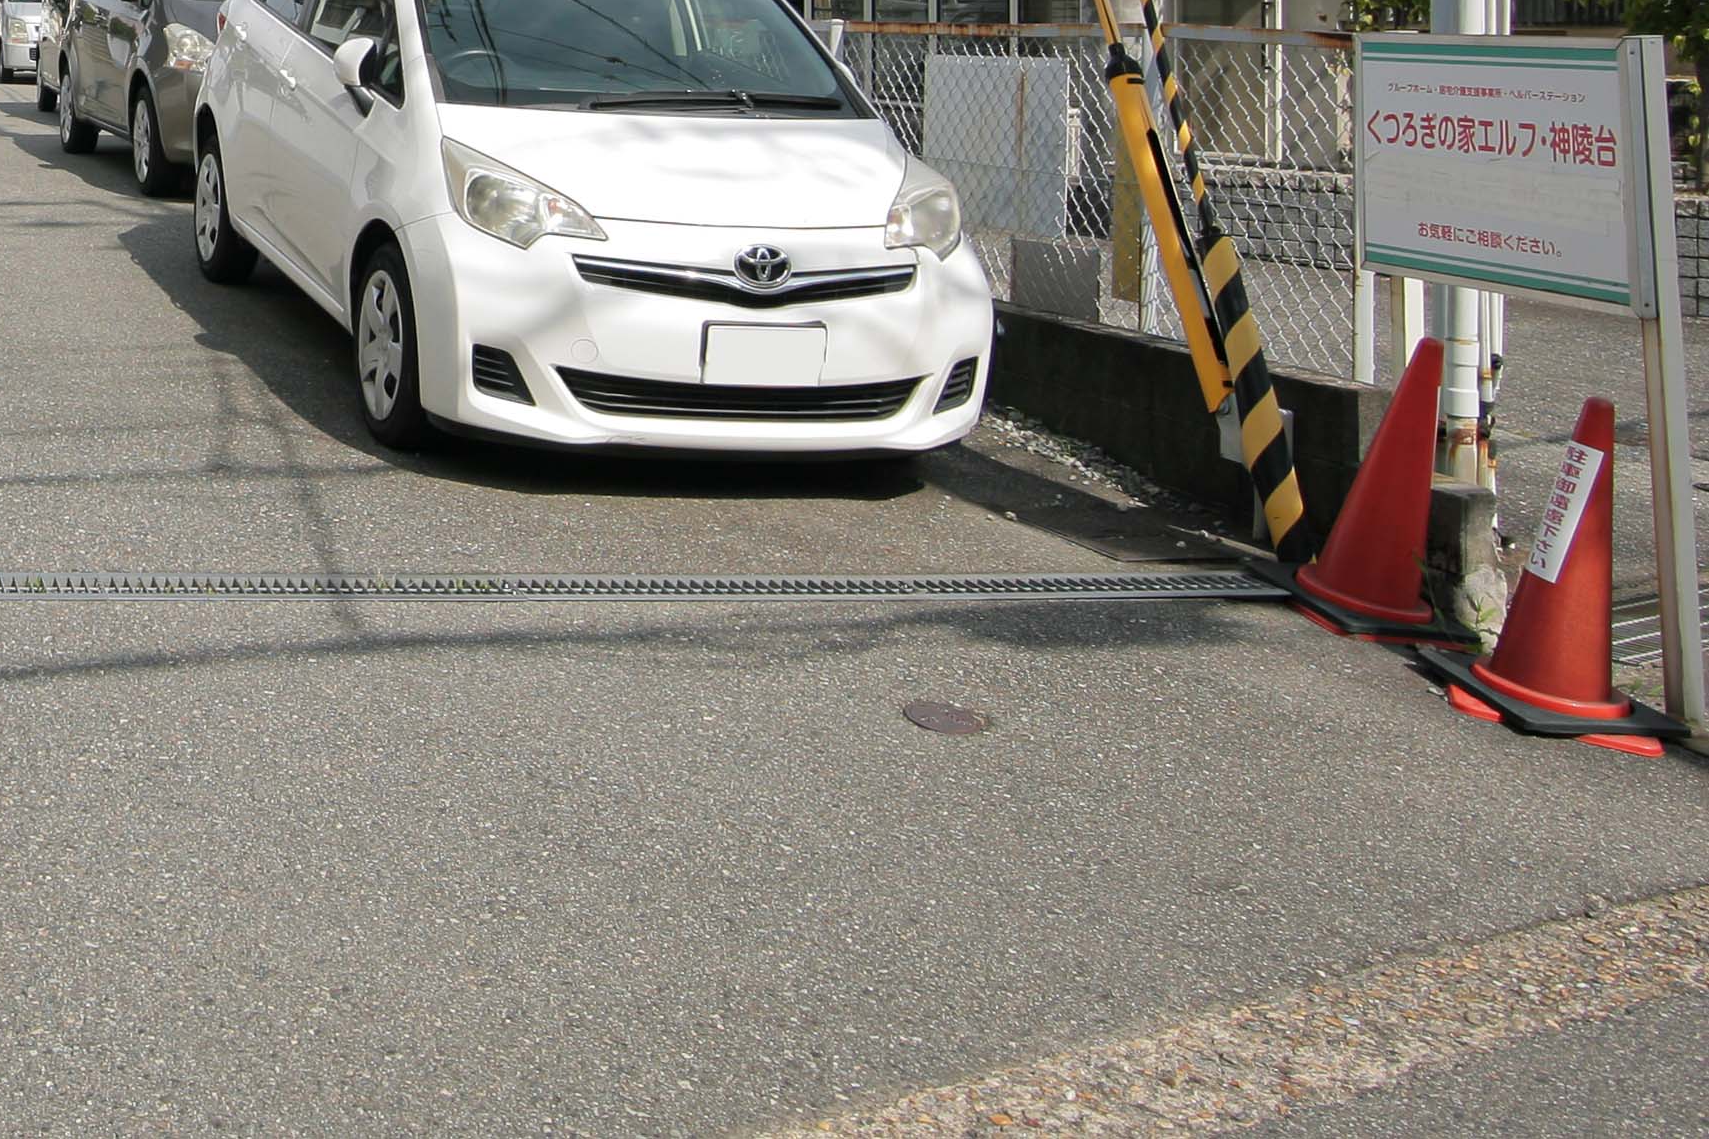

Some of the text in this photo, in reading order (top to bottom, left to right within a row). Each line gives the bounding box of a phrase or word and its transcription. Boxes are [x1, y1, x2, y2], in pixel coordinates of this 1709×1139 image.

[1367, 110, 1617, 167] くつろぎの家エルフ・神陵台
[1418, 222, 1562, 257] お気軽にご相談ください。
